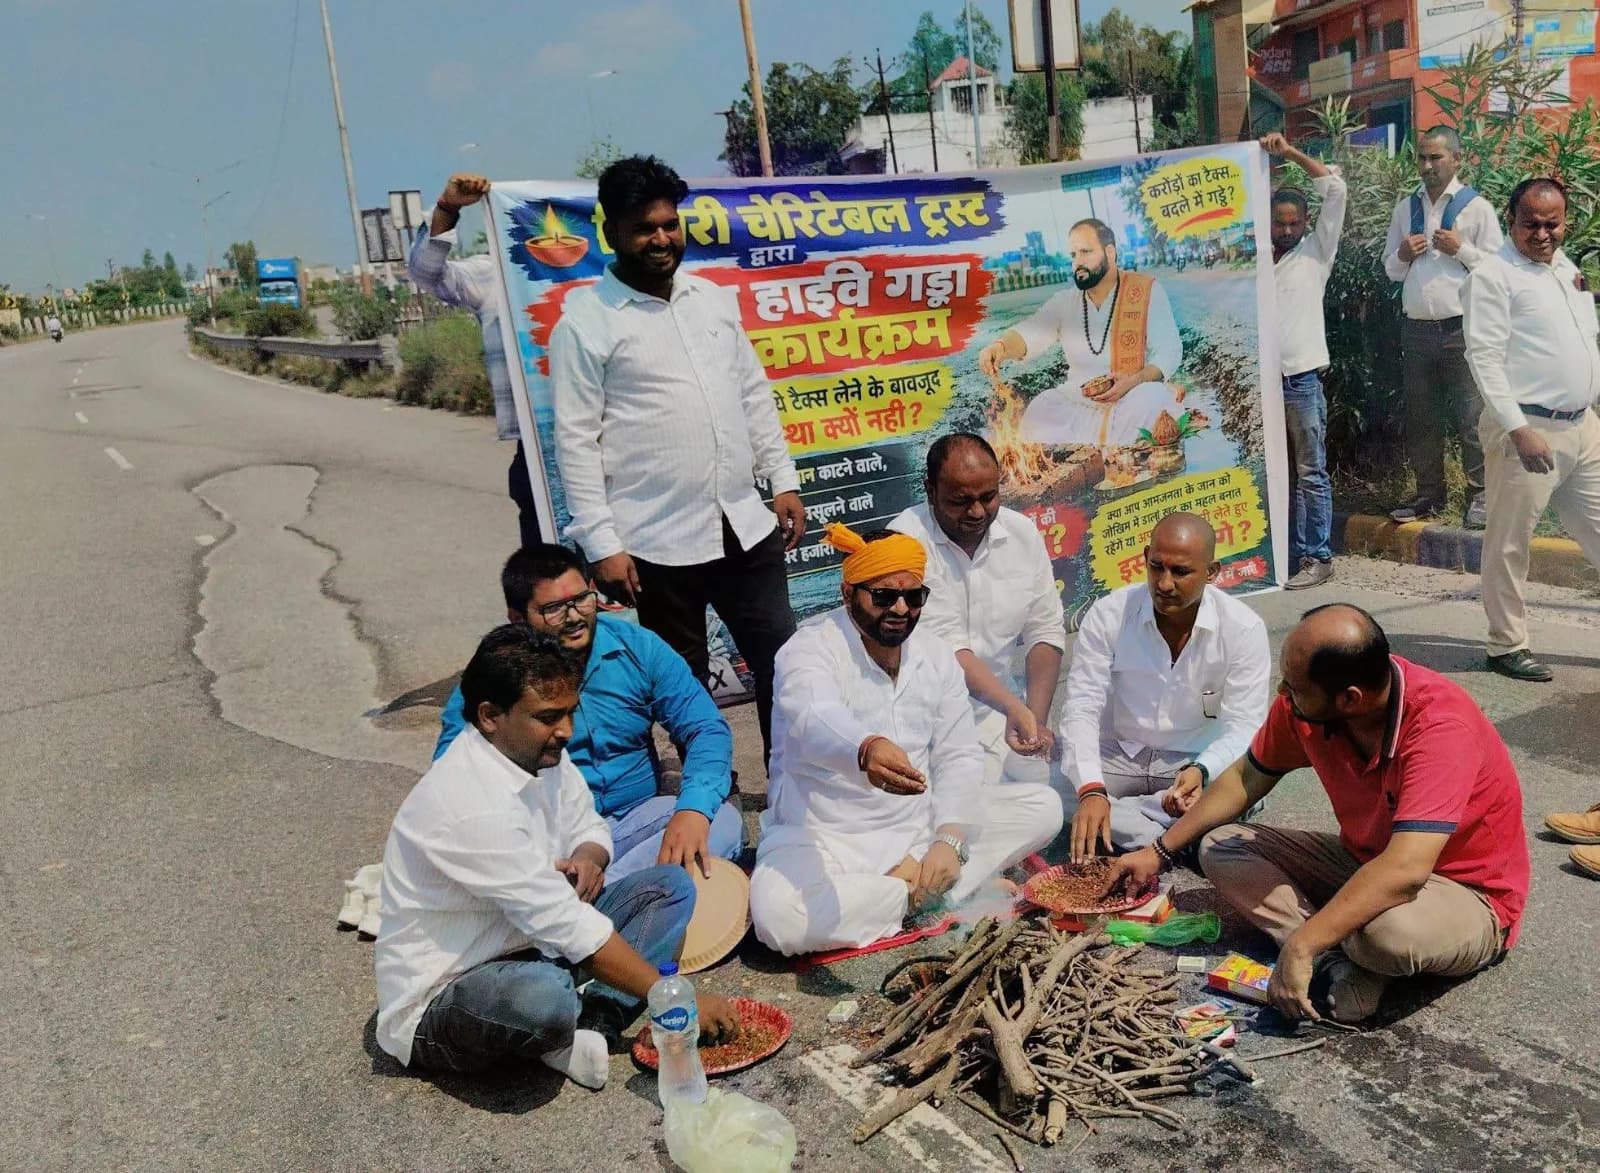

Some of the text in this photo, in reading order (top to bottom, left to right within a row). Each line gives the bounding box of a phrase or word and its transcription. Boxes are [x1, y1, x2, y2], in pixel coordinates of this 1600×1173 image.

[1185, 173, 1202, 186] का
[914, 193, 990, 239] ट्रस्ट
[1160, 195, 1190, 218] बदले
[1192, 190, 1204, 208] में
[749, 244, 797, 266] द्वारा
[746, 307, 952, 370] कार्यक्रम
[789, 386, 828, 412] टैक्स
[833, 376, 862, 404] लेने
[868, 375, 884, 399] के
[889, 369, 941, 397] बावजूद
[820, 405, 862, 440] क्यों
[816, 457, 854, 481] काटने
[848, 491, 874, 512] वाले
[1102, 522, 1131, 540] जोखिम
[1180, 501, 1193, 512] का
[1195, 494, 1216, 508] महल
[1106, 507, 1122, 520] क्या
[1124, 502, 1141, 516] आप
[1142, 488, 1183, 509] आमजनता
[1185, 483, 1195, 495] के
[1197, 479, 1216, 492] जान
[1125, 536, 1135, 547] या
[1214, 504, 1231, 520] लेते
[1233, 502, 1248, 518] हुए
